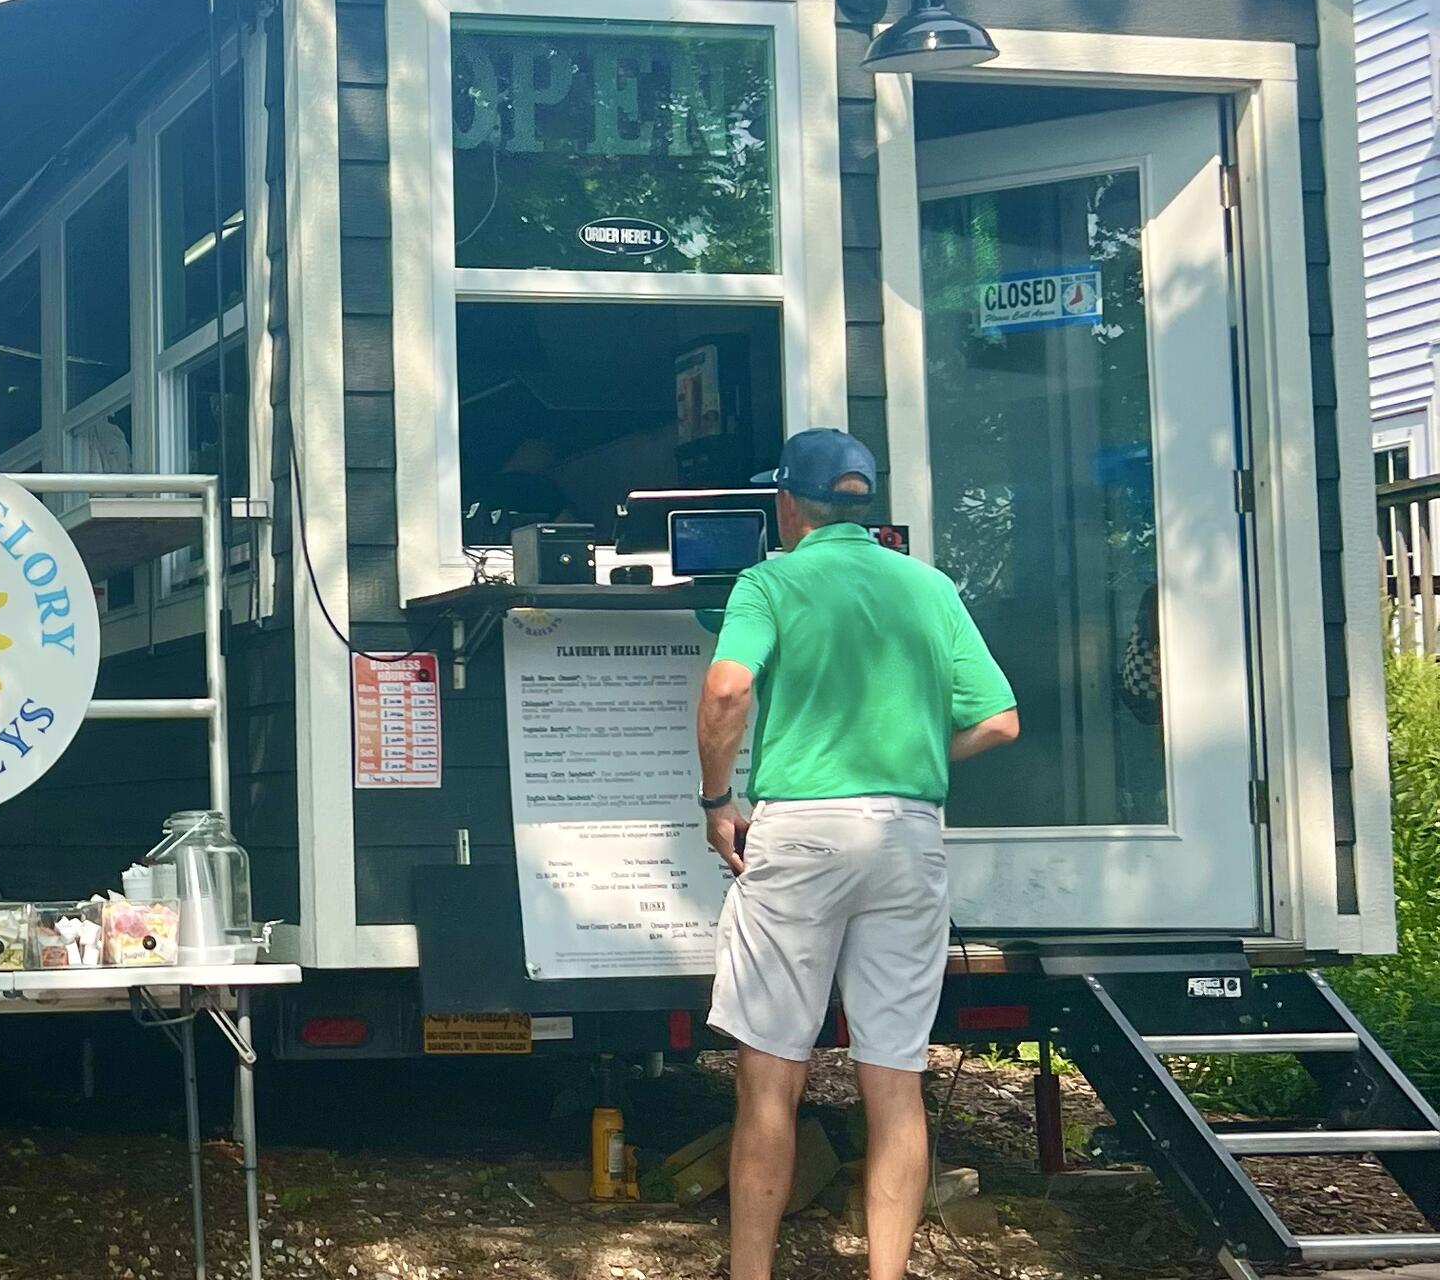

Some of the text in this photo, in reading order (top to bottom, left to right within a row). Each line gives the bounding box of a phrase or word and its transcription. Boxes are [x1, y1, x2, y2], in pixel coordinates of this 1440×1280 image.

[584, 226, 651, 244] ORDER HERE!
[984, 278, 1056, 311] CLOSED
[556, 644, 701, 657] FLAVORFUL BREAKFAST MEALS
[370, 659, 421, 671] BUSINESS
